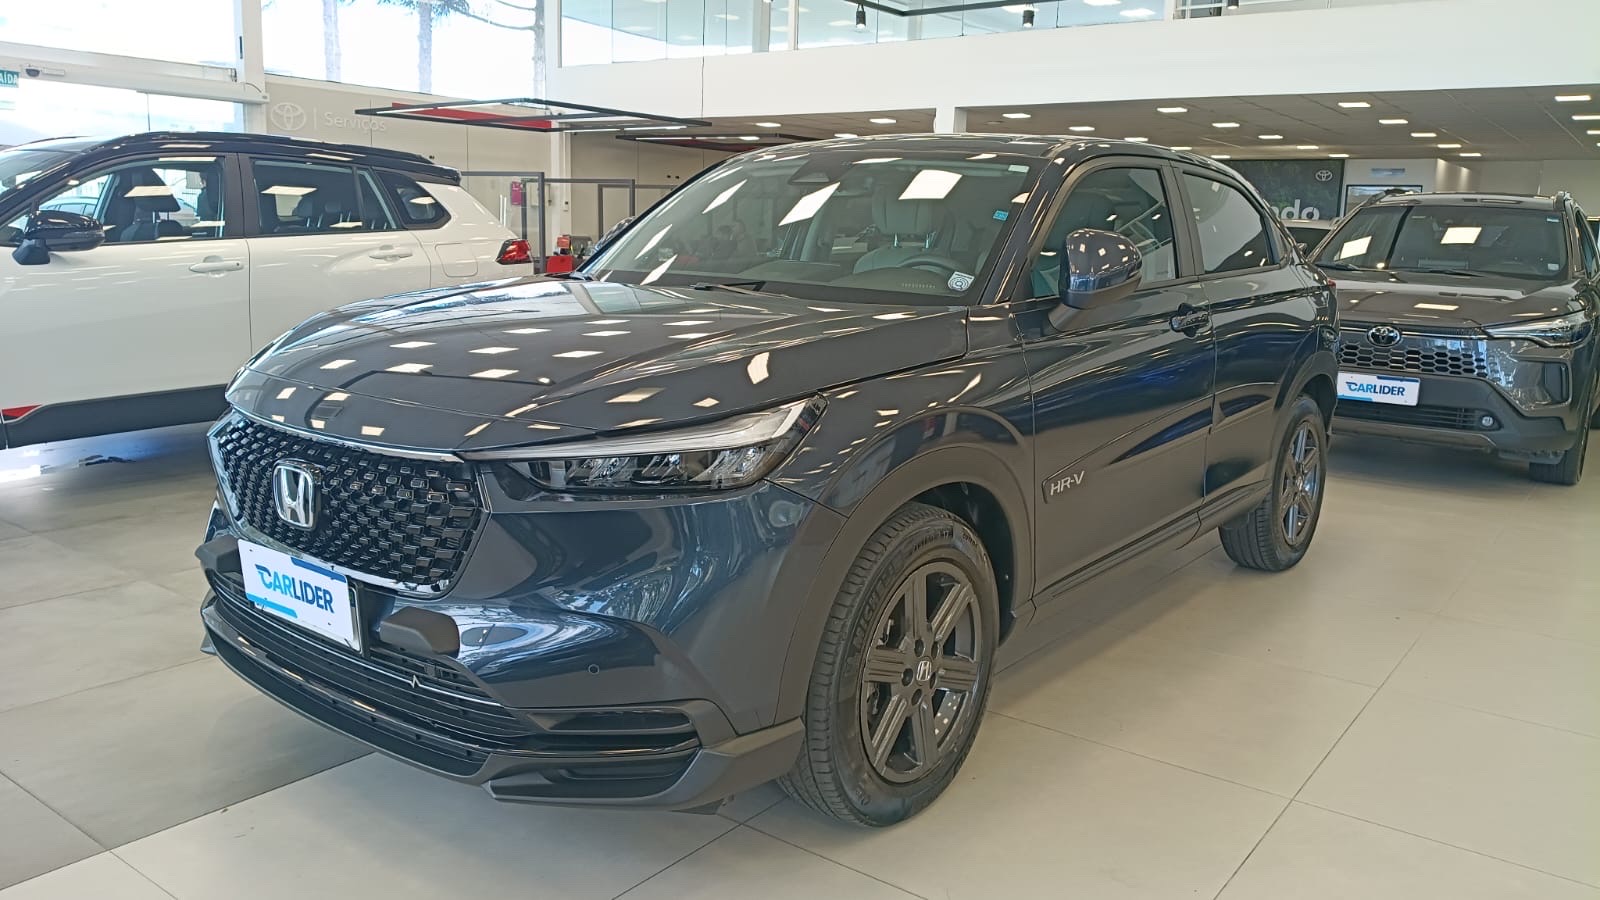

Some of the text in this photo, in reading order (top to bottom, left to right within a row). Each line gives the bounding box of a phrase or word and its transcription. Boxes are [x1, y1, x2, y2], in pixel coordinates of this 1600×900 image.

[323, 111, 386, 136] Serviços
[1345, 381, 1406, 397] CARLIDER
[1050, 470, 1085, 496] HR-V
[255, 563, 335, 614] CARLIDER
